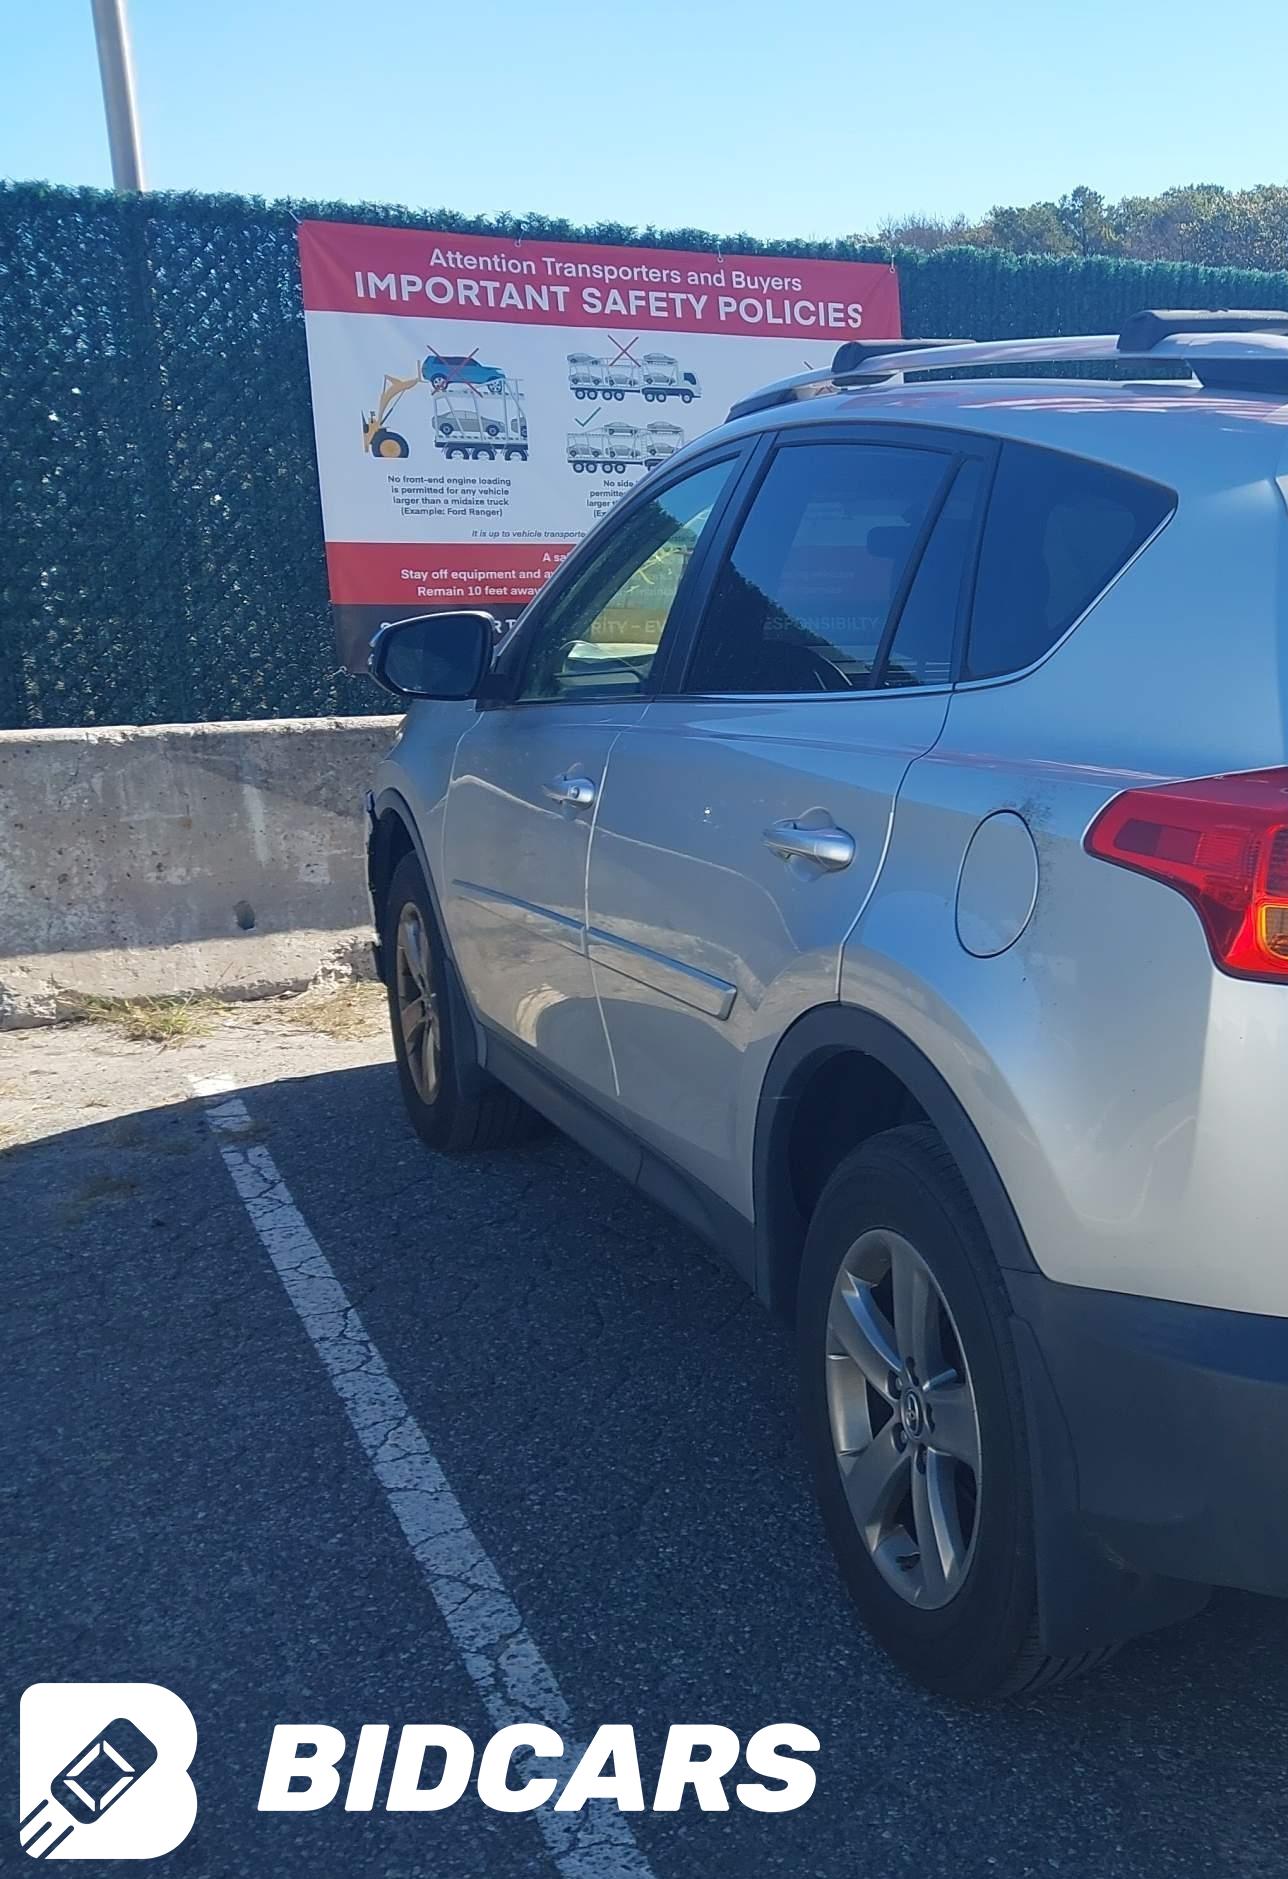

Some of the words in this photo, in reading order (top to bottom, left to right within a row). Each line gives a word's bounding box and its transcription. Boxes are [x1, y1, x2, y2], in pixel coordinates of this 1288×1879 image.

[430, 248, 536, 275] Attention
[542, 257, 681, 284] Transporters
[687, 269, 725, 287] and
[732, 271, 802, 294] Buyers
[355, 271, 570, 312] IMPORTANT
[582, 287, 708, 320] SAFETY
[718, 296, 863, 329] POLICIES
[387, 475, 400, 484] No
[403, 475, 444, 484] front-end
[446, 476, 477, 486] engine
[479, 477, 511, 487] loading
[401, 486, 444, 496] permitted
[446, 486, 458, 495] for
[460, 488, 477, 497] any
[478, 487, 510, 496] vehicle
[590, 490, 625, 498] permitte
[393, 496, 419, 506] larger
[421, 496, 441, 505] than
[451, 497, 485, 506] midsize
[487, 498, 509, 506] truck
[587, 499, 610, 508] larger
[401, 506, 446, 516] (Example:
[447, 507, 467, 516] Ford
[469, 508, 503, 517] Ranger)
[512, 530, 542, 538] vehicle
[544, 530, 586, 539] transporte
[542, 552, 551, 562] A
[400, 569, 428, 582] Stay
[431, 568, 449, 579] off
[451, 569, 516, 582] equipment
[518, 569, 541, 579] and
[417, 586, 464, 597] Remain
[467, 586, 482, 596] 10
[484, 585, 508, 596] feet
